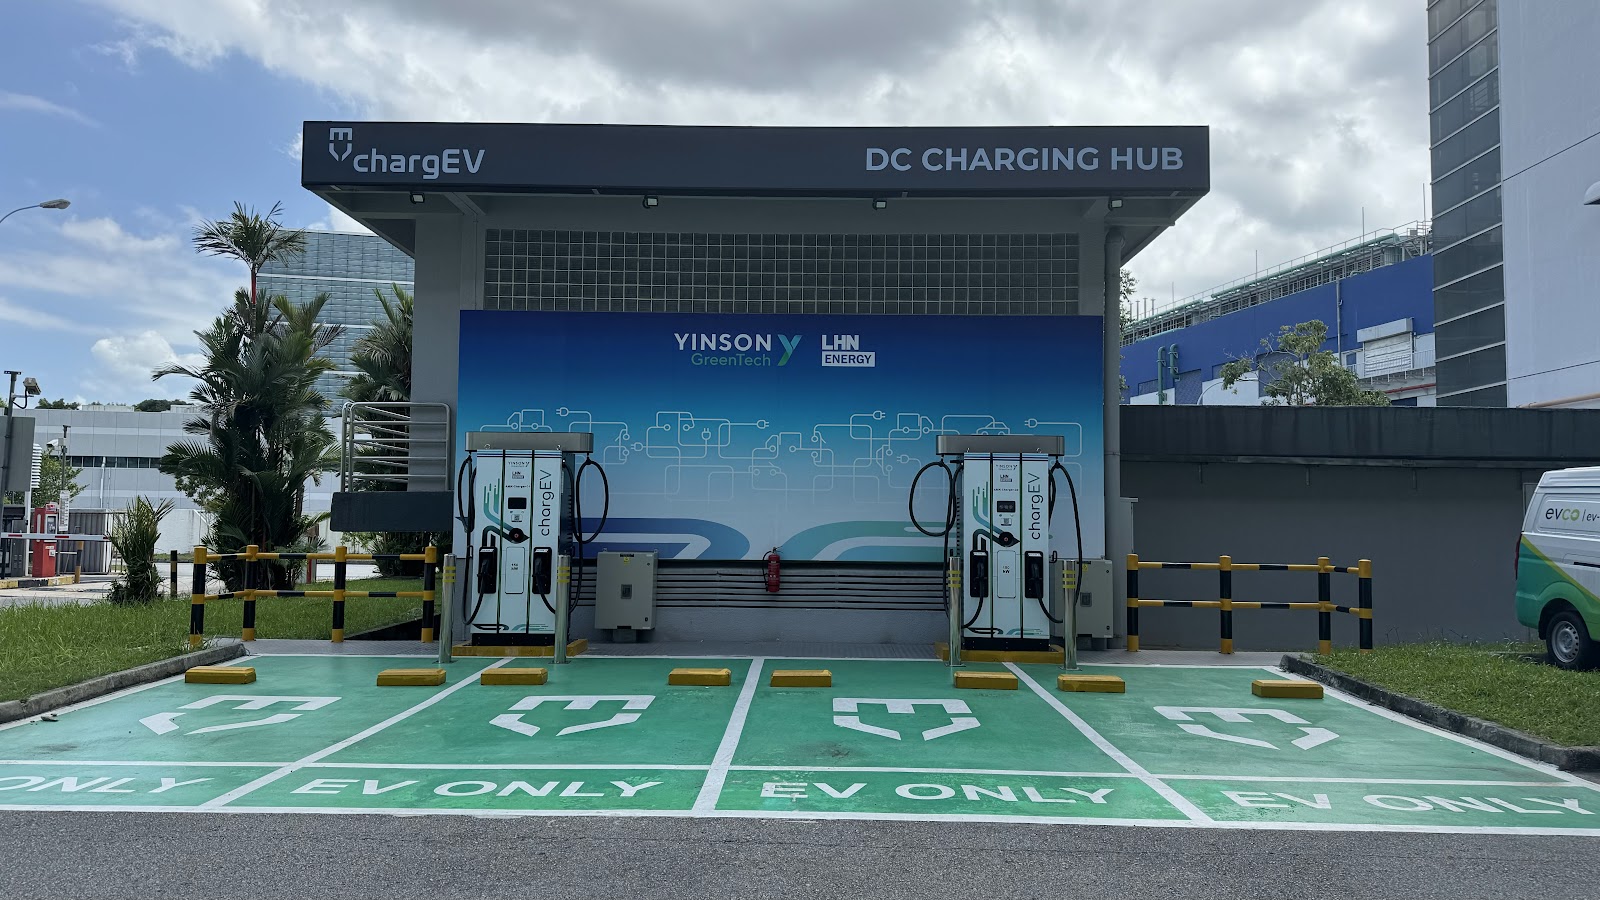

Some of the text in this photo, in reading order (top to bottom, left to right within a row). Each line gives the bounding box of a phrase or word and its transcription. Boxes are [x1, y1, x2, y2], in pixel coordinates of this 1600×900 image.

[353, 148, 485, 180] chargEV
[865, 147, 1184, 172] DC CHARGING HUB
[674, 332, 772, 351] YINSON
[821, 334, 859, 350] LHN
[691, 353, 771, 366] GreenTech
[824, 354, 872, 364] ENERGY
[538, 469, 555, 536] chargEV
[1028, 472, 1043, 540] chargEV
[1545, 507, 1580, 521] evco
[0, 775, 216, 793] ONLY
[290, 778, 664, 797] EV ONLY
[760, 782, 1115, 804] EV ONLY
[1221, 790, 1596, 815] EV ONLY
